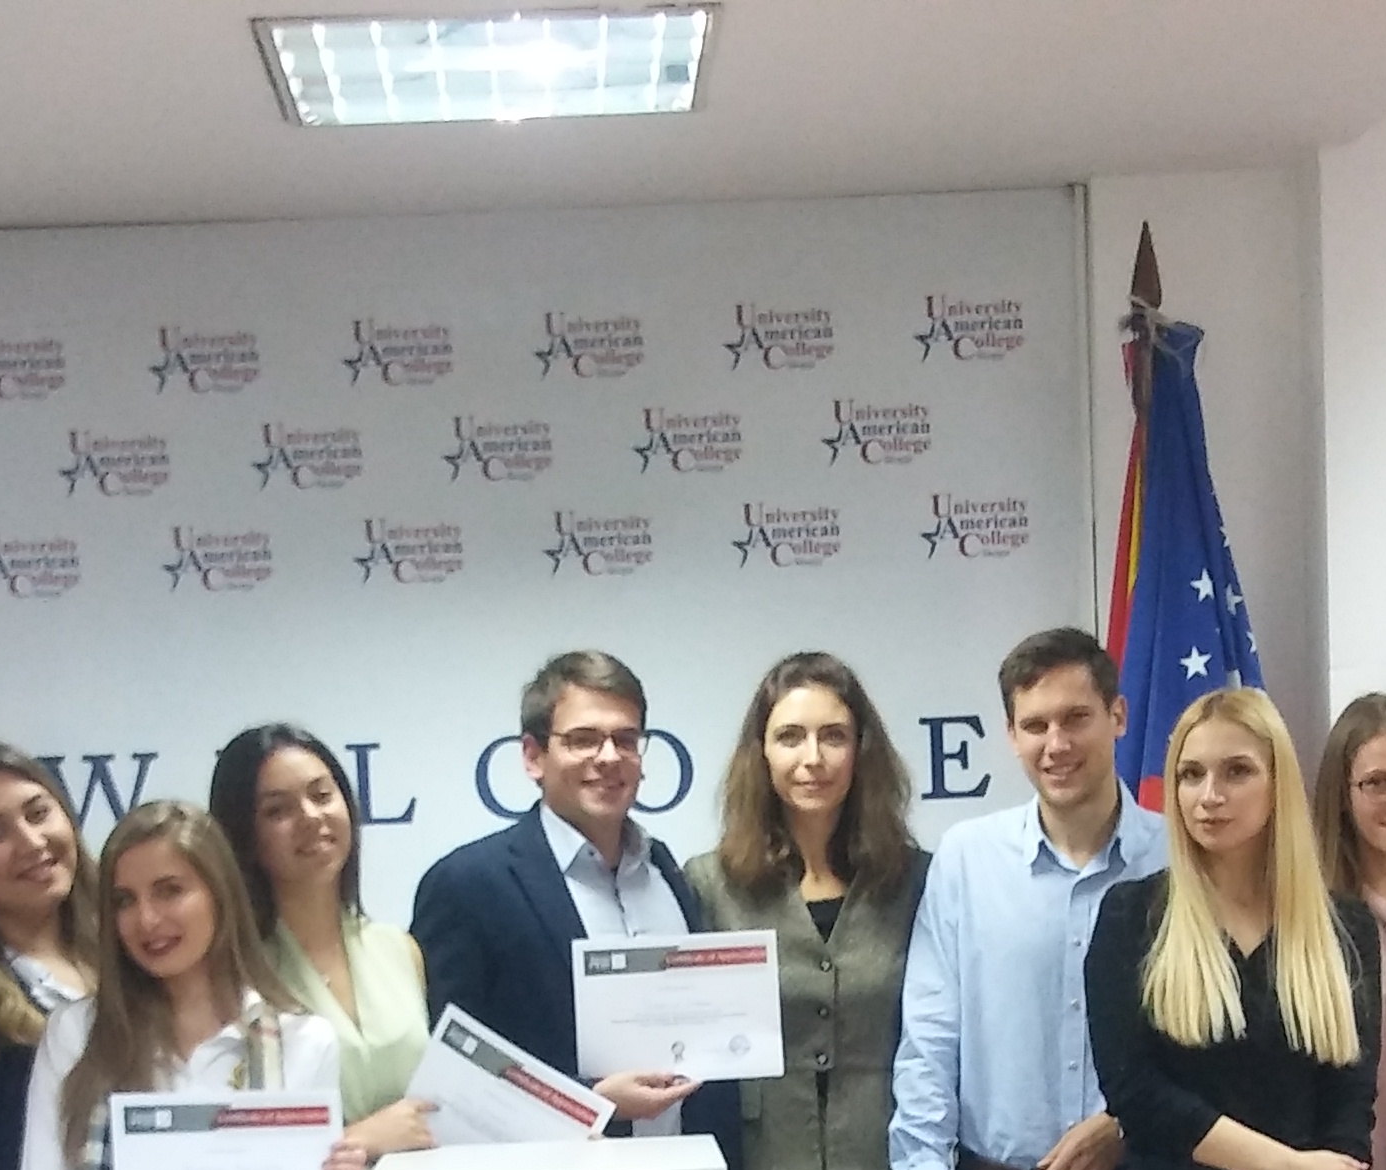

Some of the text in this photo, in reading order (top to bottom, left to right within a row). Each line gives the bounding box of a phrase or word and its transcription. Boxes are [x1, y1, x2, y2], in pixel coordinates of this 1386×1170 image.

[925, 295, 1022, 320] University
[928, 318, 1024, 341] American
[953, 334, 1025, 360] College
[832, 399, 928, 424] University
[835, 422, 930, 445] American
[860, 438, 931, 464] College
[743, 502, 840, 527] University
[932, 494, 1028, 519] University
[746, 525, 840, 548] American
[935, 517, 1029, 540] American
[770, 541, 841, 567] College
[958, 532, 1030, 558] College
